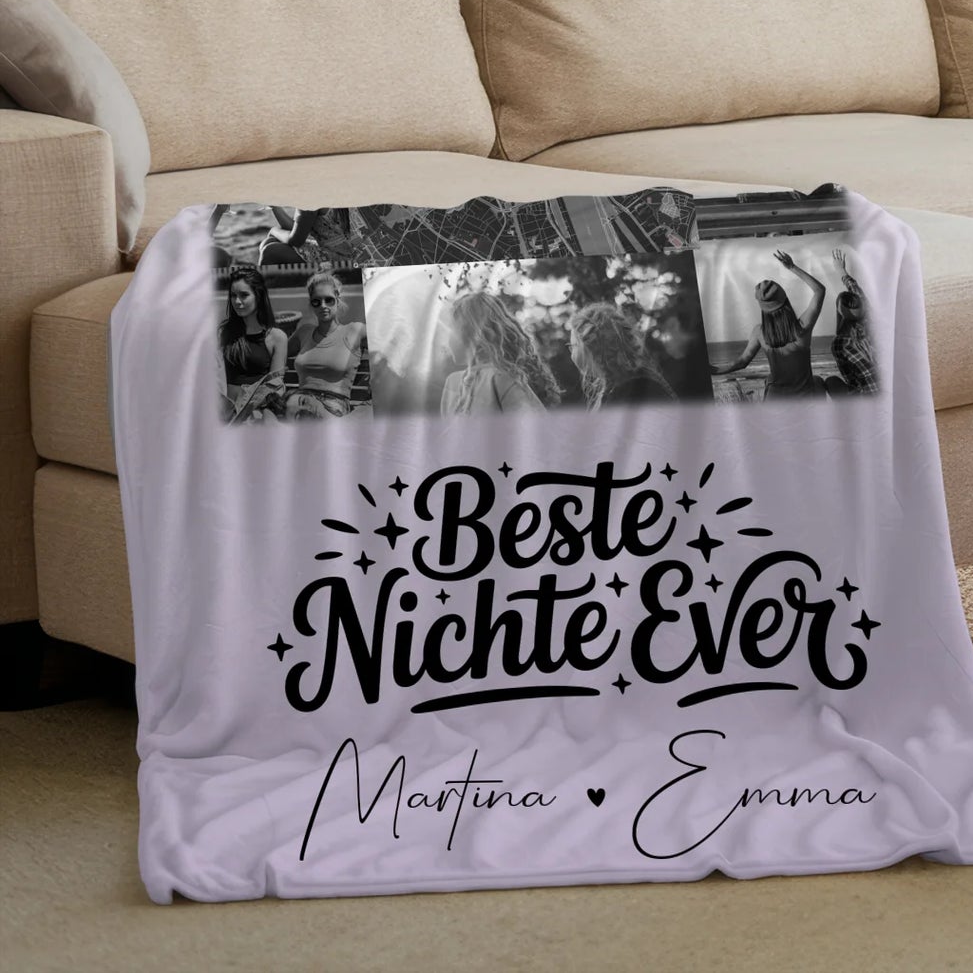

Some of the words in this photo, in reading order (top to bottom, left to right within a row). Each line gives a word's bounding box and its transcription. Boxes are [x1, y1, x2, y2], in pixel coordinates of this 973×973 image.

[411, 461, 678, 582] Beste
[284, 567, 621, 713] Nichte
[630, 550, 868, 691] Ever
[299, 737, 557, 862] Martina
[631, 729, 877, 860] Emma
